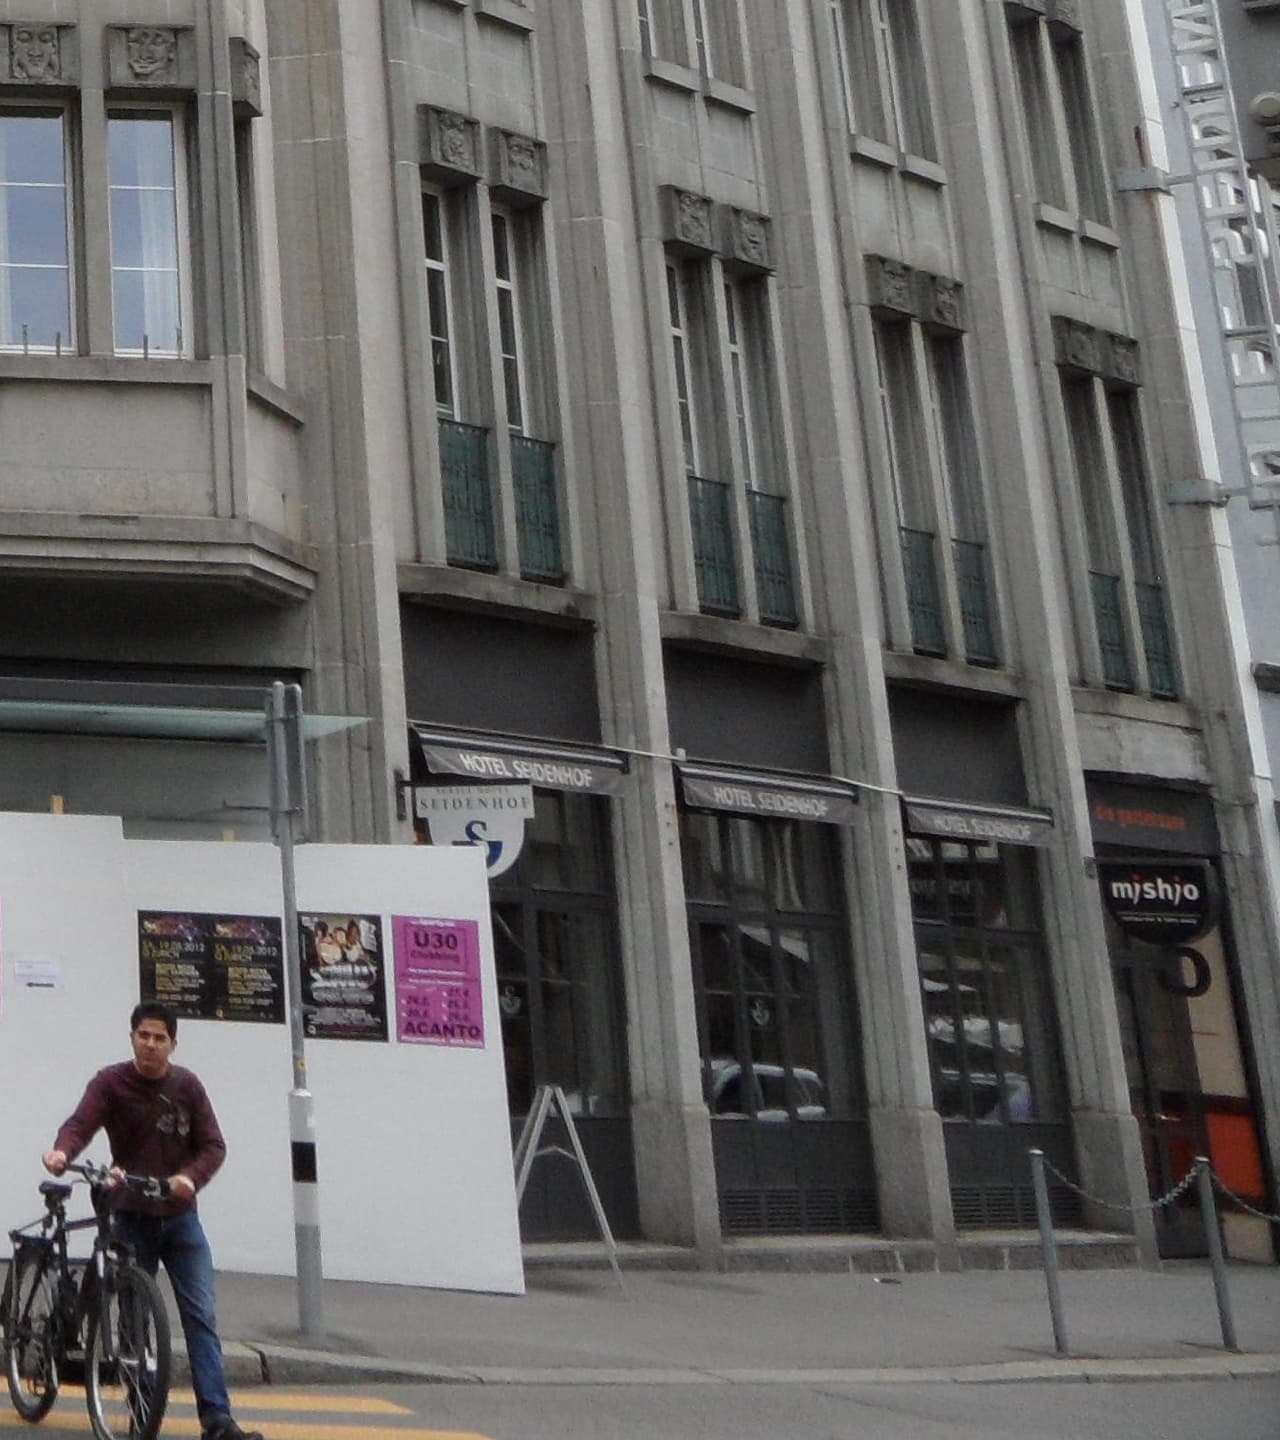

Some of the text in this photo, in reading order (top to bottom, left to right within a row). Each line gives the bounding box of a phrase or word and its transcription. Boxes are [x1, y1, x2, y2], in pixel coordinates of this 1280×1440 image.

[459, 752, 593, 788] HOTEL SEIDENHOF
[419, 796, 530, 810] SEIDENHOF
[713, 786, 829, 817] HOTEL SEIDENHOF
[1111, 873, 1200, 907] mishio
[405, 1021, 481, 1040] ACANTO
